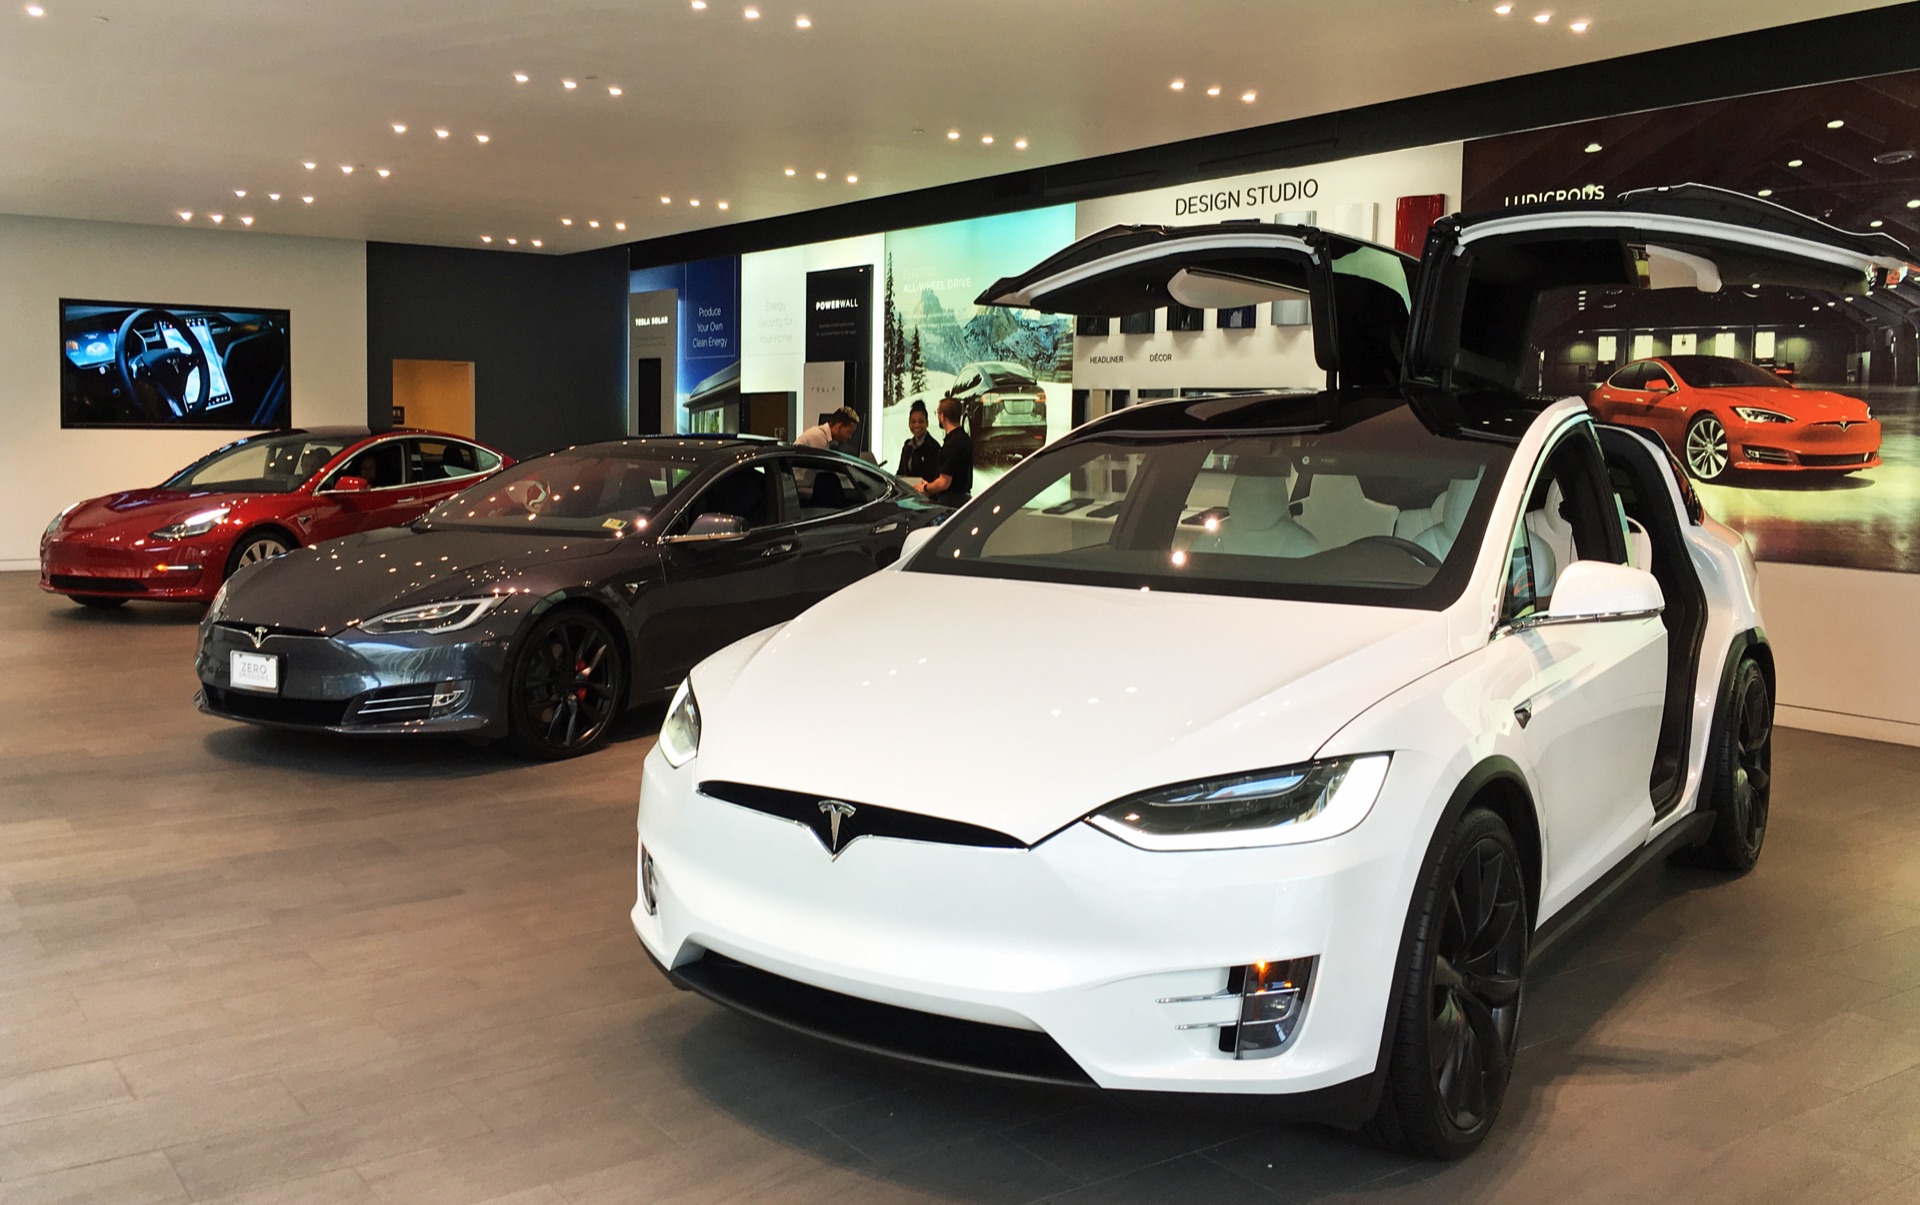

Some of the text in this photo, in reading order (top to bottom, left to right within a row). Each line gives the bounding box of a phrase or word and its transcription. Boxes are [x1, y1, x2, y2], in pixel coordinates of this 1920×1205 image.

[1175, 178, 1319, 216] DESIGN STUDIO
[903, 277, 971, 294] ALL-WHEEL DRIVE
[765, 301, 787, 313] Energy
[815, 298, 859, 311] POWERWALL
[698, 306, 722, 318] Produce
[635, 316, 669, 327] TESLA SOLAR
[696, 321, 724, 333] Your Own
[692, 336, 728, 349] Clean Energy
[760, 333, 793, 344] Your Home
[1089, 355, 1124, 364] HEADLINER
[1149, 352, 1173, 362] DÉCOR
[241, 662, 267, 675] ZERO
